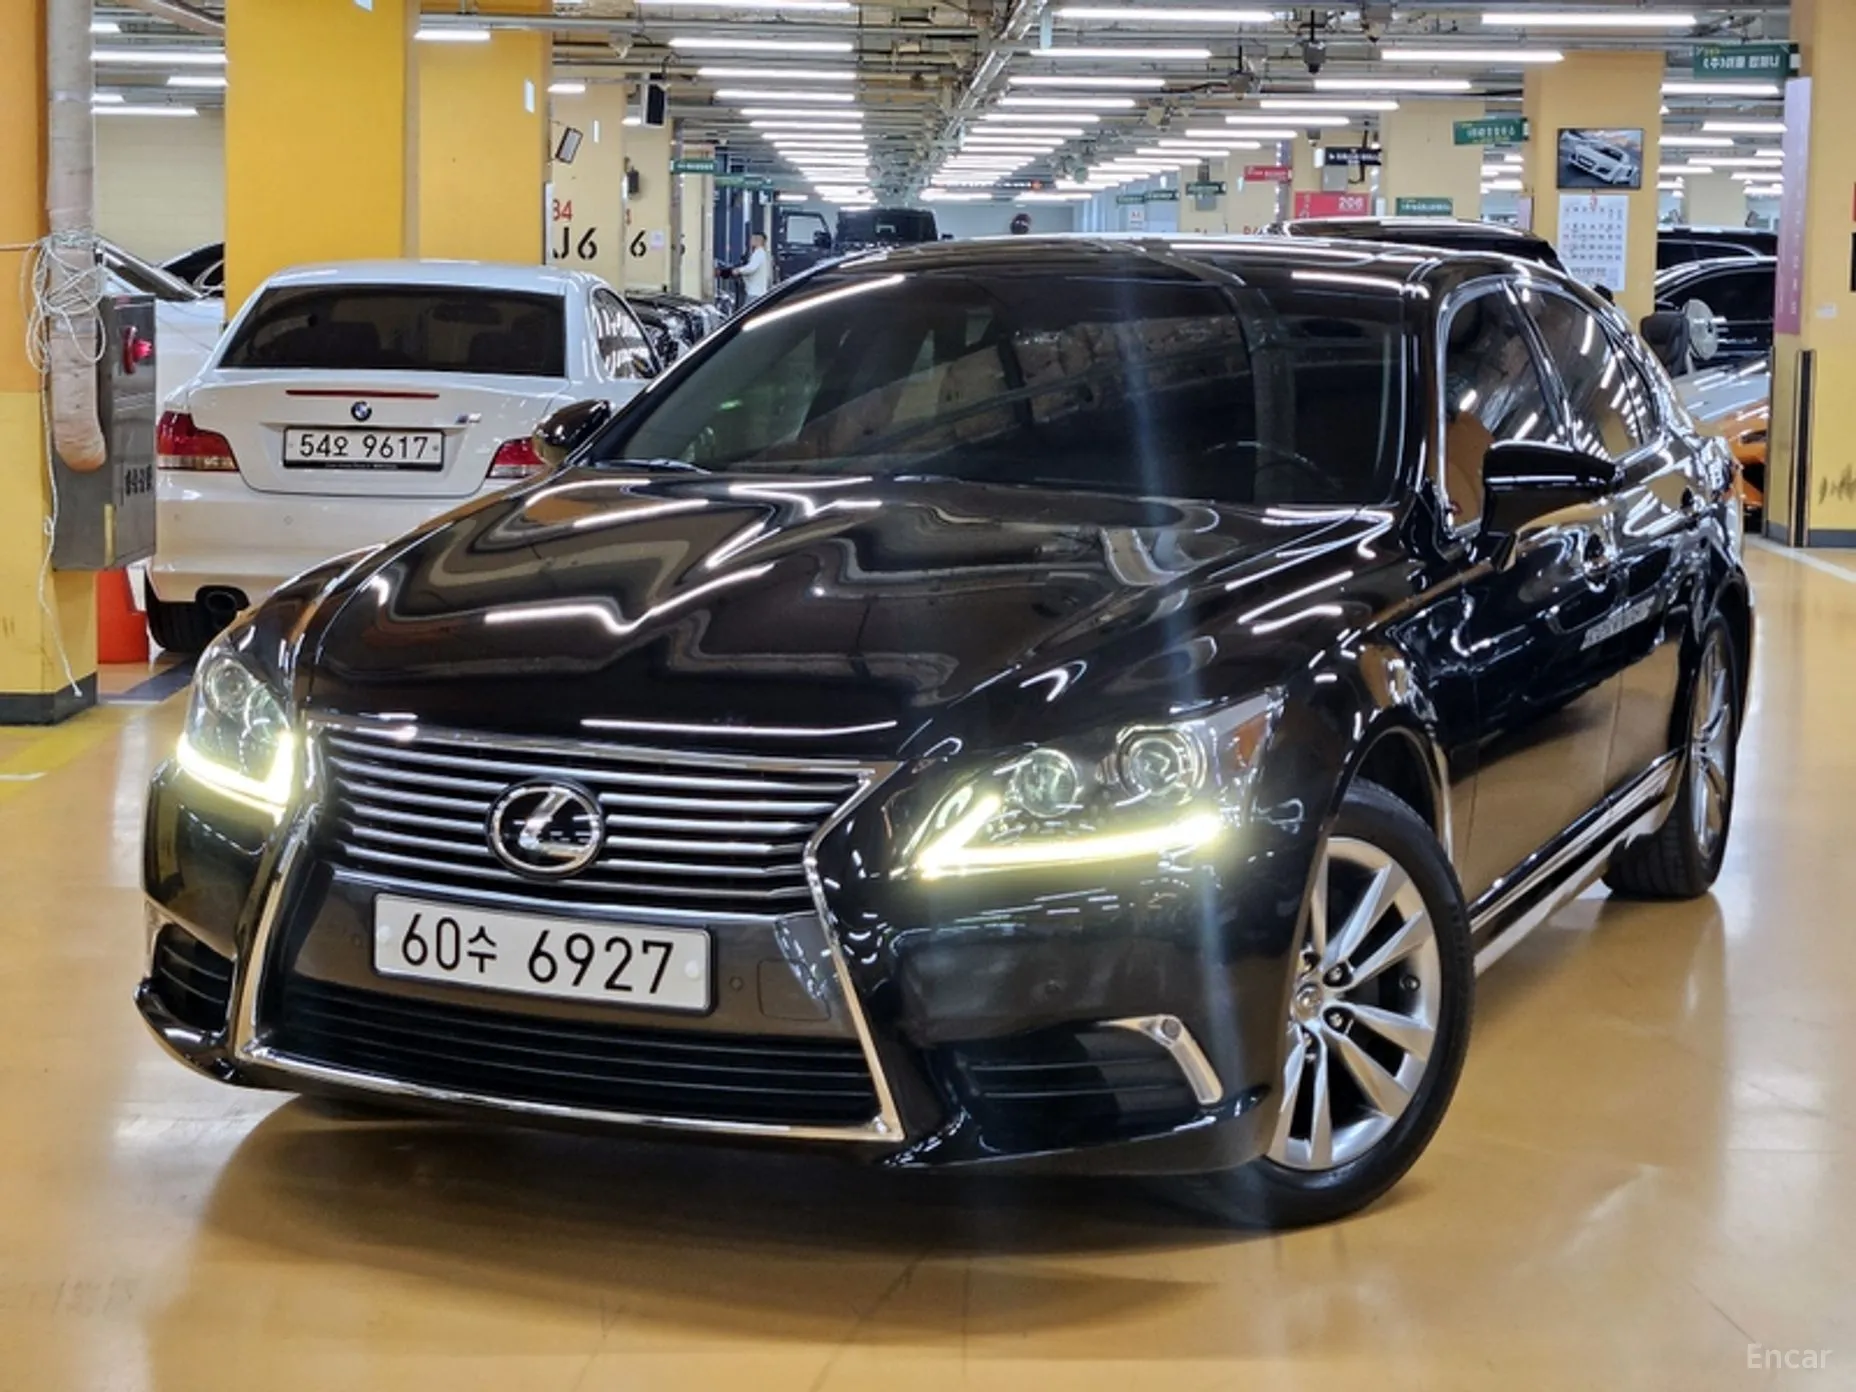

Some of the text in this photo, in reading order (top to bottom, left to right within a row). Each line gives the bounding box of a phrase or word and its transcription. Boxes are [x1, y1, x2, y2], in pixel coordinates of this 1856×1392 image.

[299, 433, 429, 459] 54오 9617
[401, 912, 675, 994] 60수 6927
